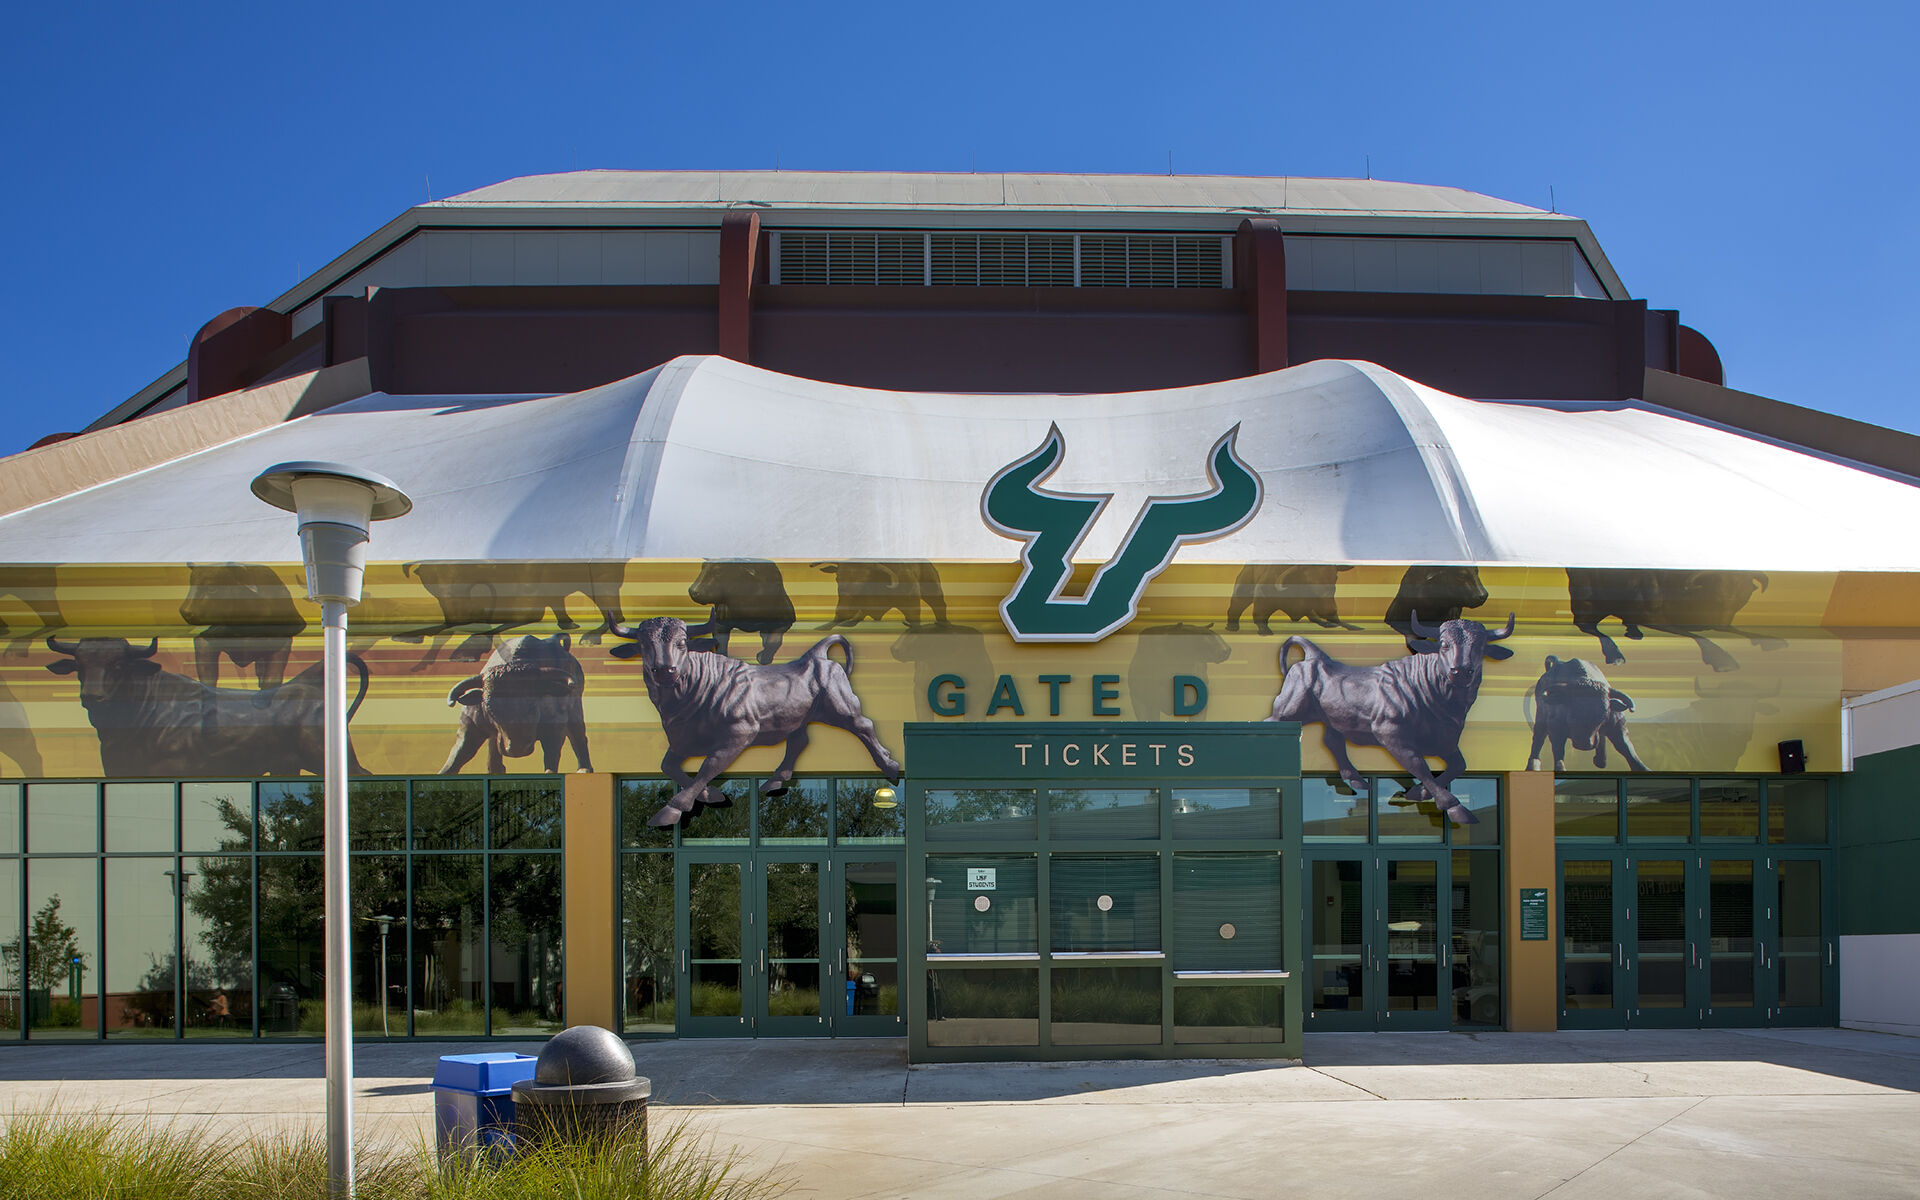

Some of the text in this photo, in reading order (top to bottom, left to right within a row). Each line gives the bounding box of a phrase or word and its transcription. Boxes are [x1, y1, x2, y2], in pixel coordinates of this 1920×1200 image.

[927, 673, 1209, 717] GATE D
[1014, 743, 1195, 767] TICKETS
